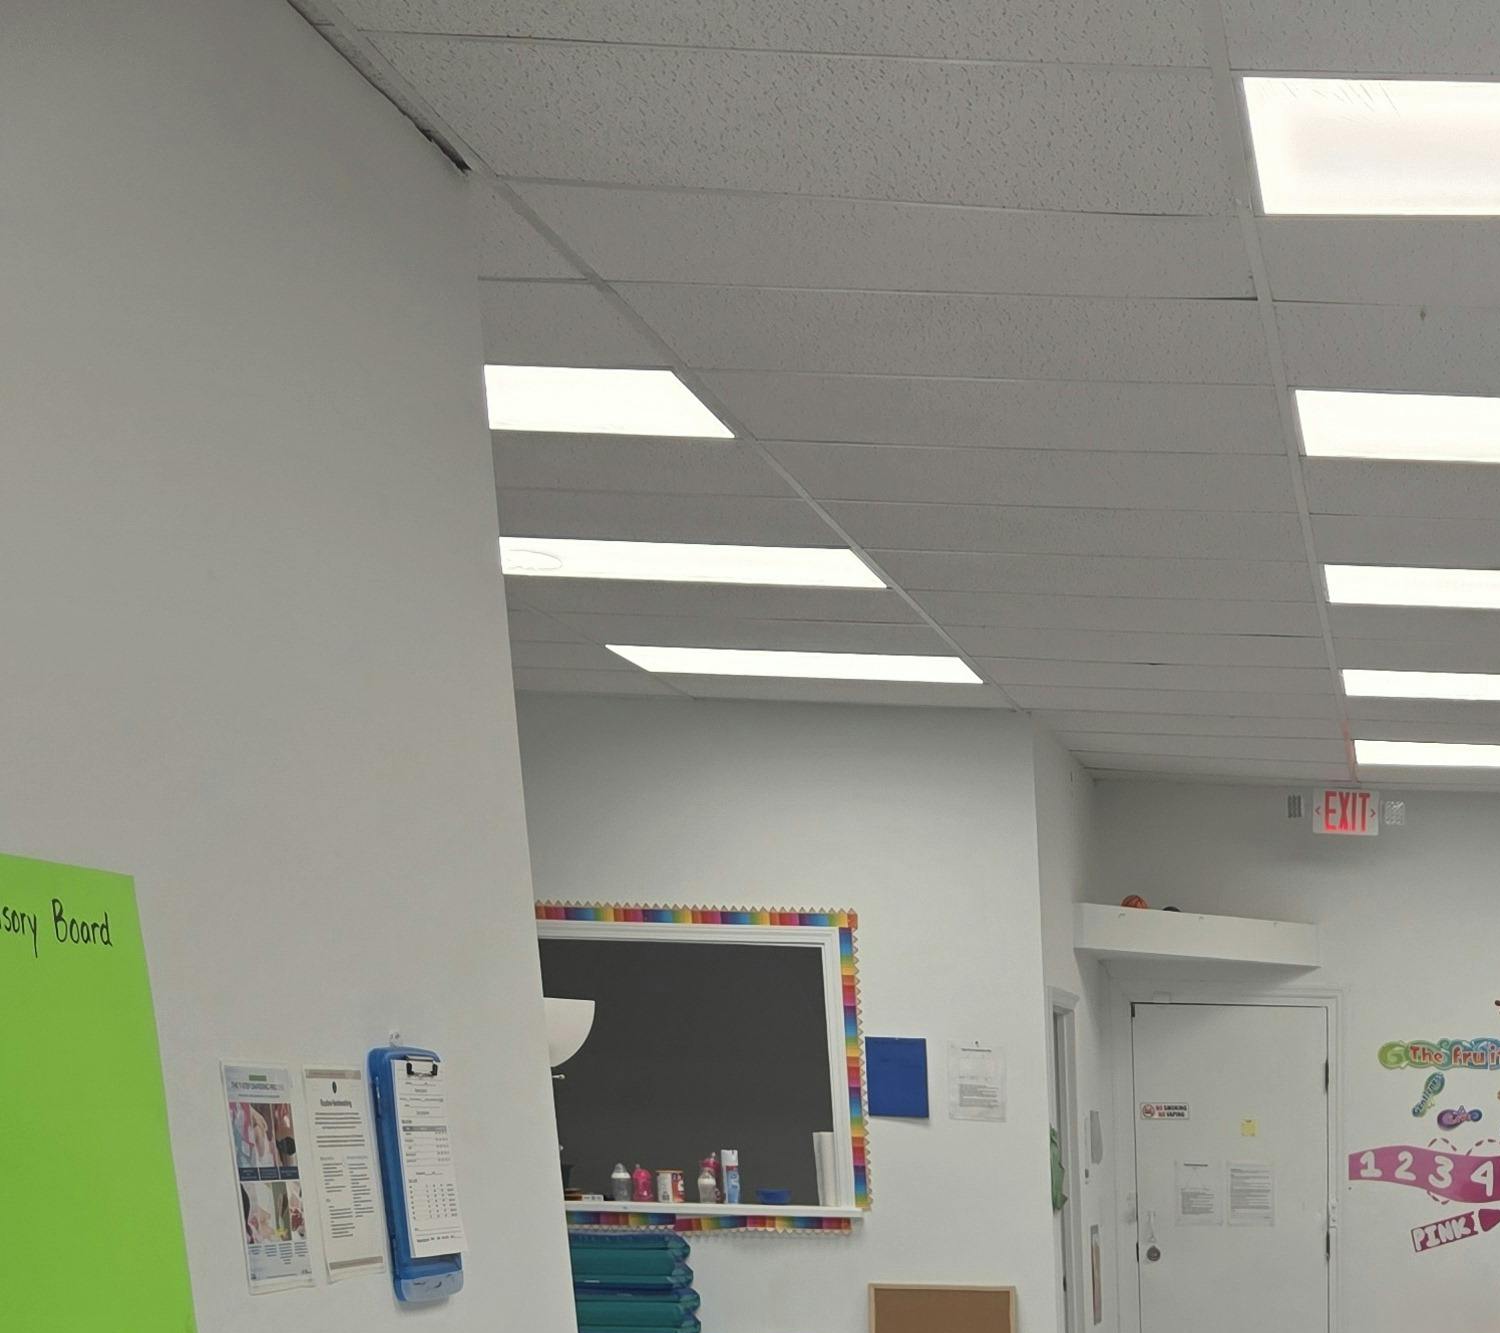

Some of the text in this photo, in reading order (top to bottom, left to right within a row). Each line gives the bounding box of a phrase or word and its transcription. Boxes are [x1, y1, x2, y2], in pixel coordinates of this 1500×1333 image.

[1325, 788, 1371, 833] EXIT
[51, 898, 113, 947] Board
[1409, 1044, 1444, 1065] The
[1360, 1150, 1383, 1178] 1
[1394, 1151, 1416, 1181] 2
[1428, 1156, 1455, 1189] 3
[1470, 1160, 1495, 1197] 4
[1413, 1216, 1474, 1253] PINK
